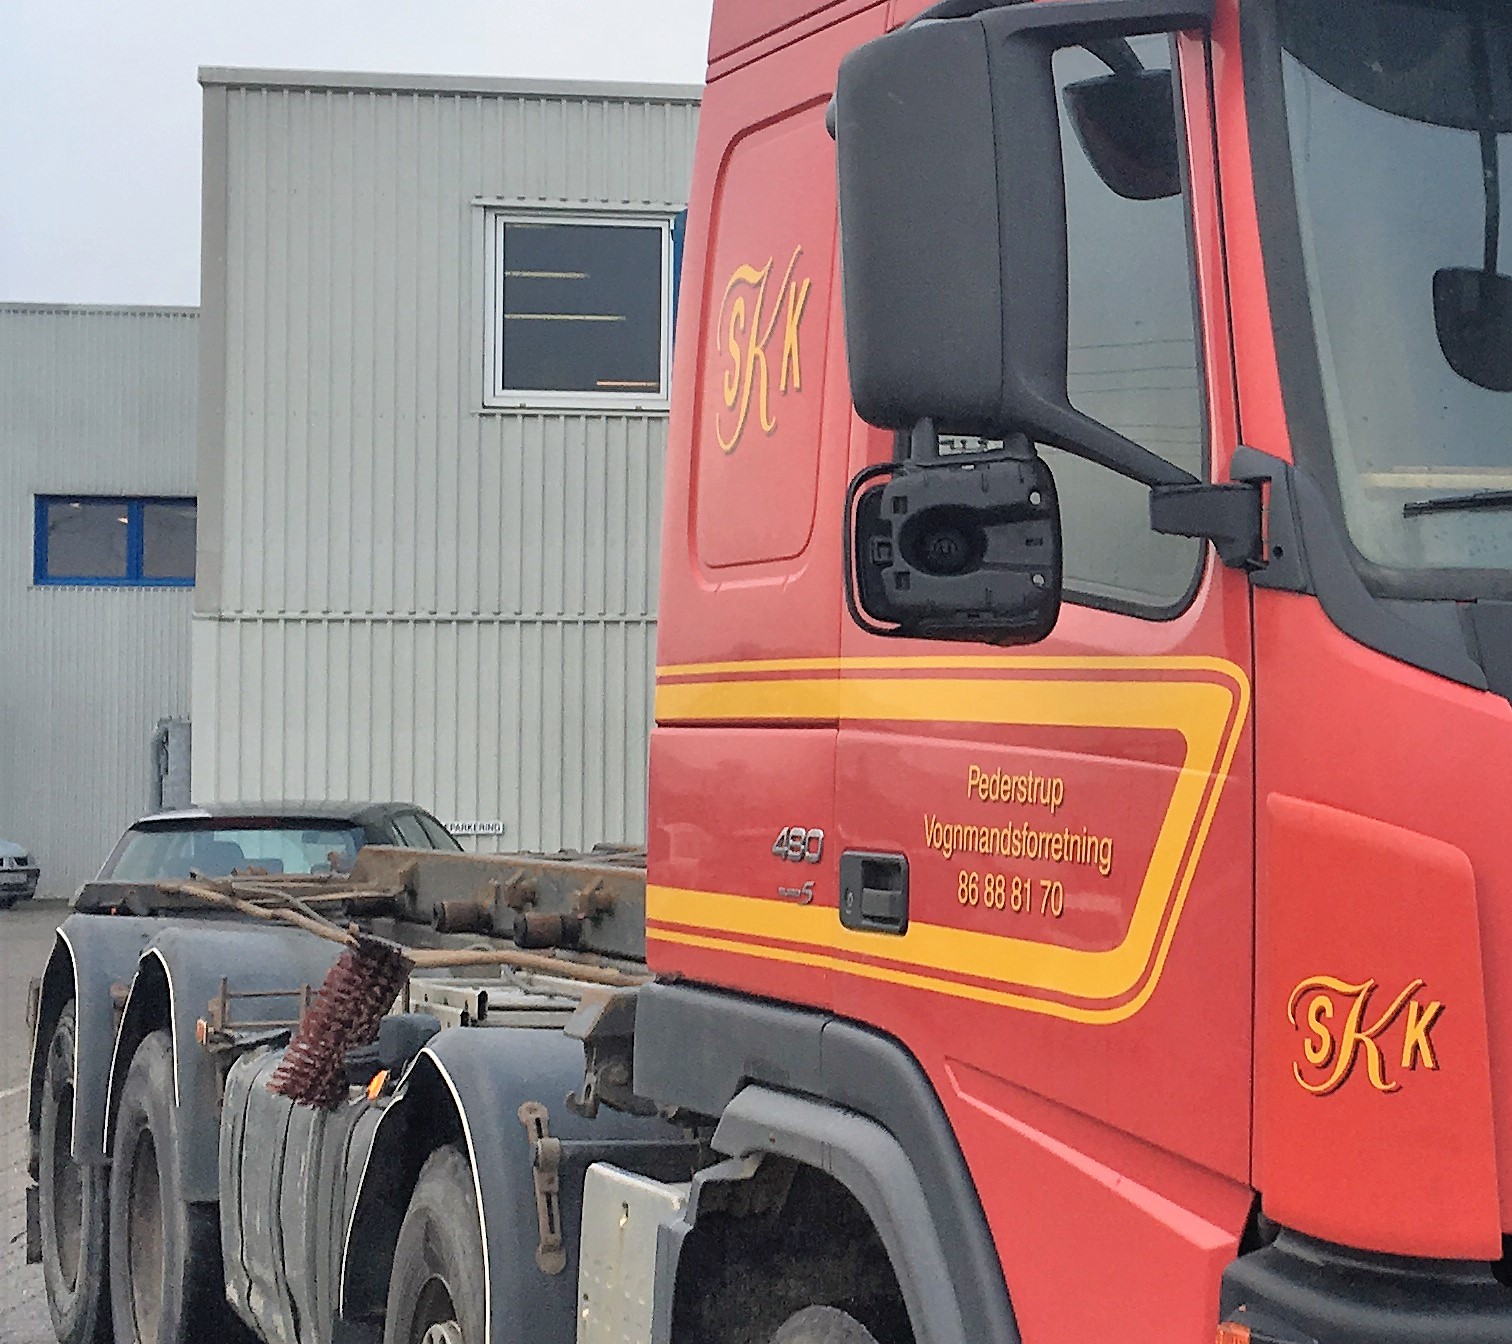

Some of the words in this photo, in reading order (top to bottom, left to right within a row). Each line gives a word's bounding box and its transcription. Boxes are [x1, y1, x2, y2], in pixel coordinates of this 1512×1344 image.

[967, 764, 1064, 814] Pederstrup
[772, 826, 824, 864] 480
[924, 813, 1113, 876] Vognmandsforretning
[957, 869, 979, 906] 86
[984, 872, 1006, 910] 88
[1010, 875, 1031, 912] 81
[1039, 879, 1064, 917] 70
